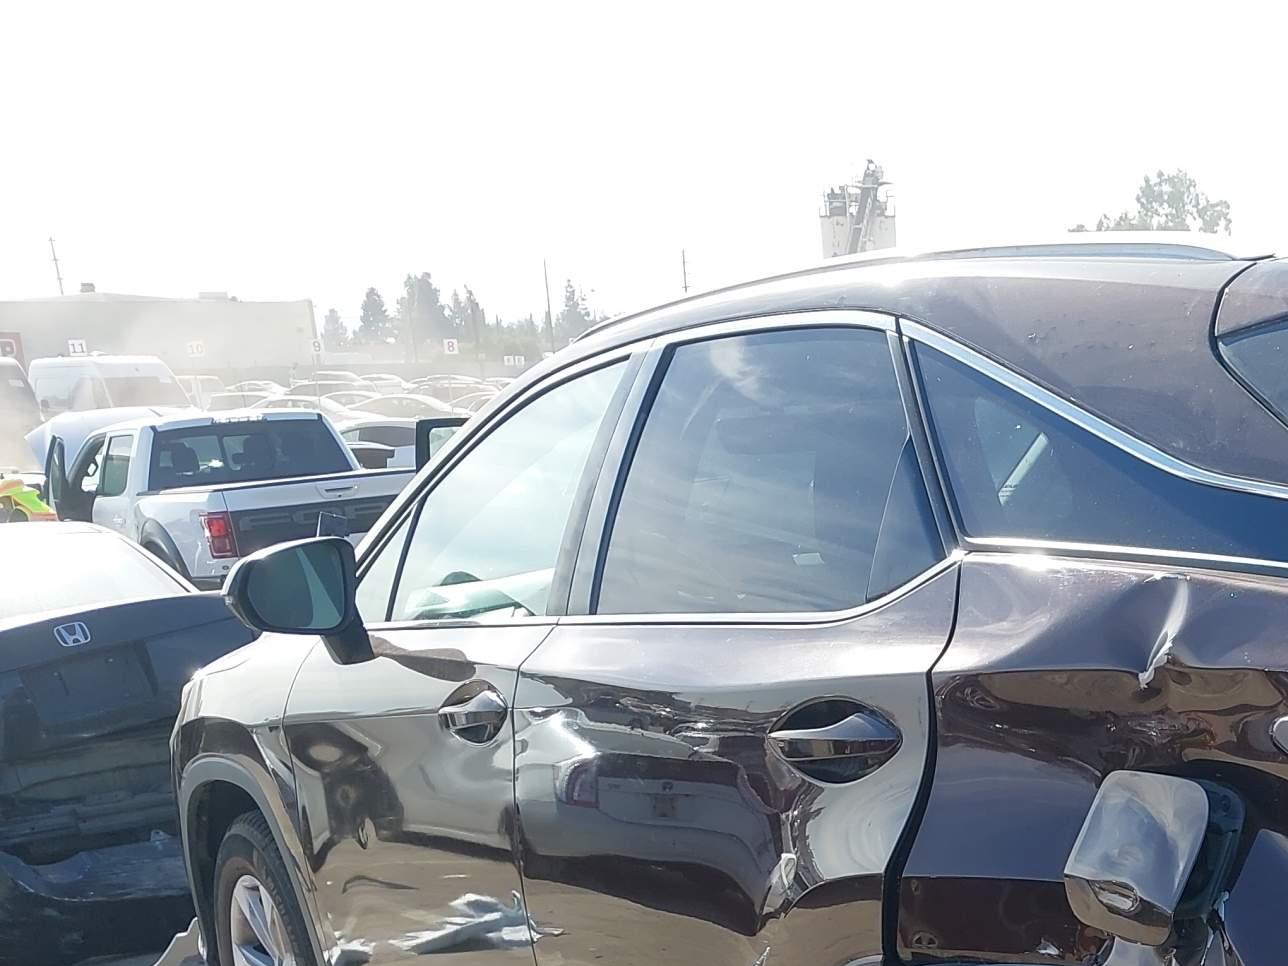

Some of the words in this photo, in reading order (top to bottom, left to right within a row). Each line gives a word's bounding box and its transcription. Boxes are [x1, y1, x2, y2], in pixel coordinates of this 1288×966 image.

[70, 343, 85, 354] 11
[313, 340, 321, 353] 9
[447, 341, 456, 353] 8
